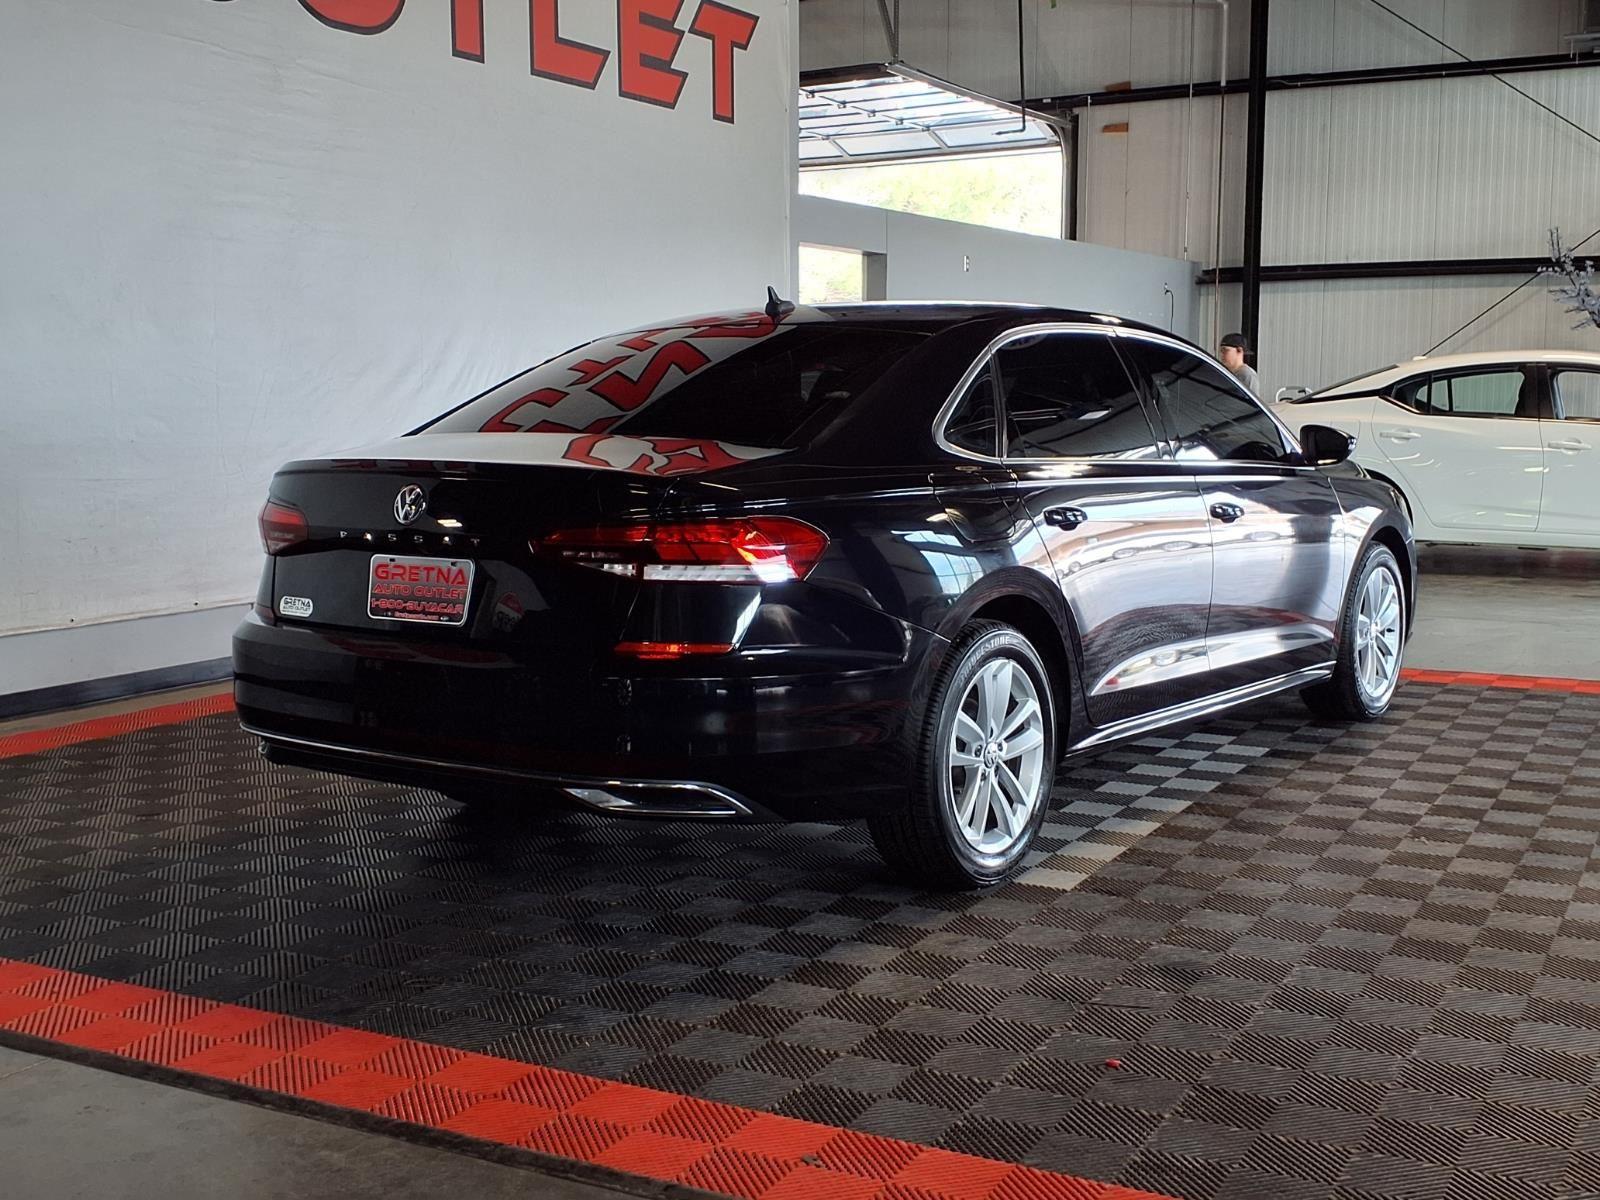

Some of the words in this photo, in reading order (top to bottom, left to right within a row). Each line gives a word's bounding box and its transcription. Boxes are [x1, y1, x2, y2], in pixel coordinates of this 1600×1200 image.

[210, 0, 759, 124] LET
[374, 563, 467, 585] GRETNA
[372, 583, 412, 596] AUTO
[414, 585, 468, 599] OUTLET
[283, 597, 311, 607] GRETNA
